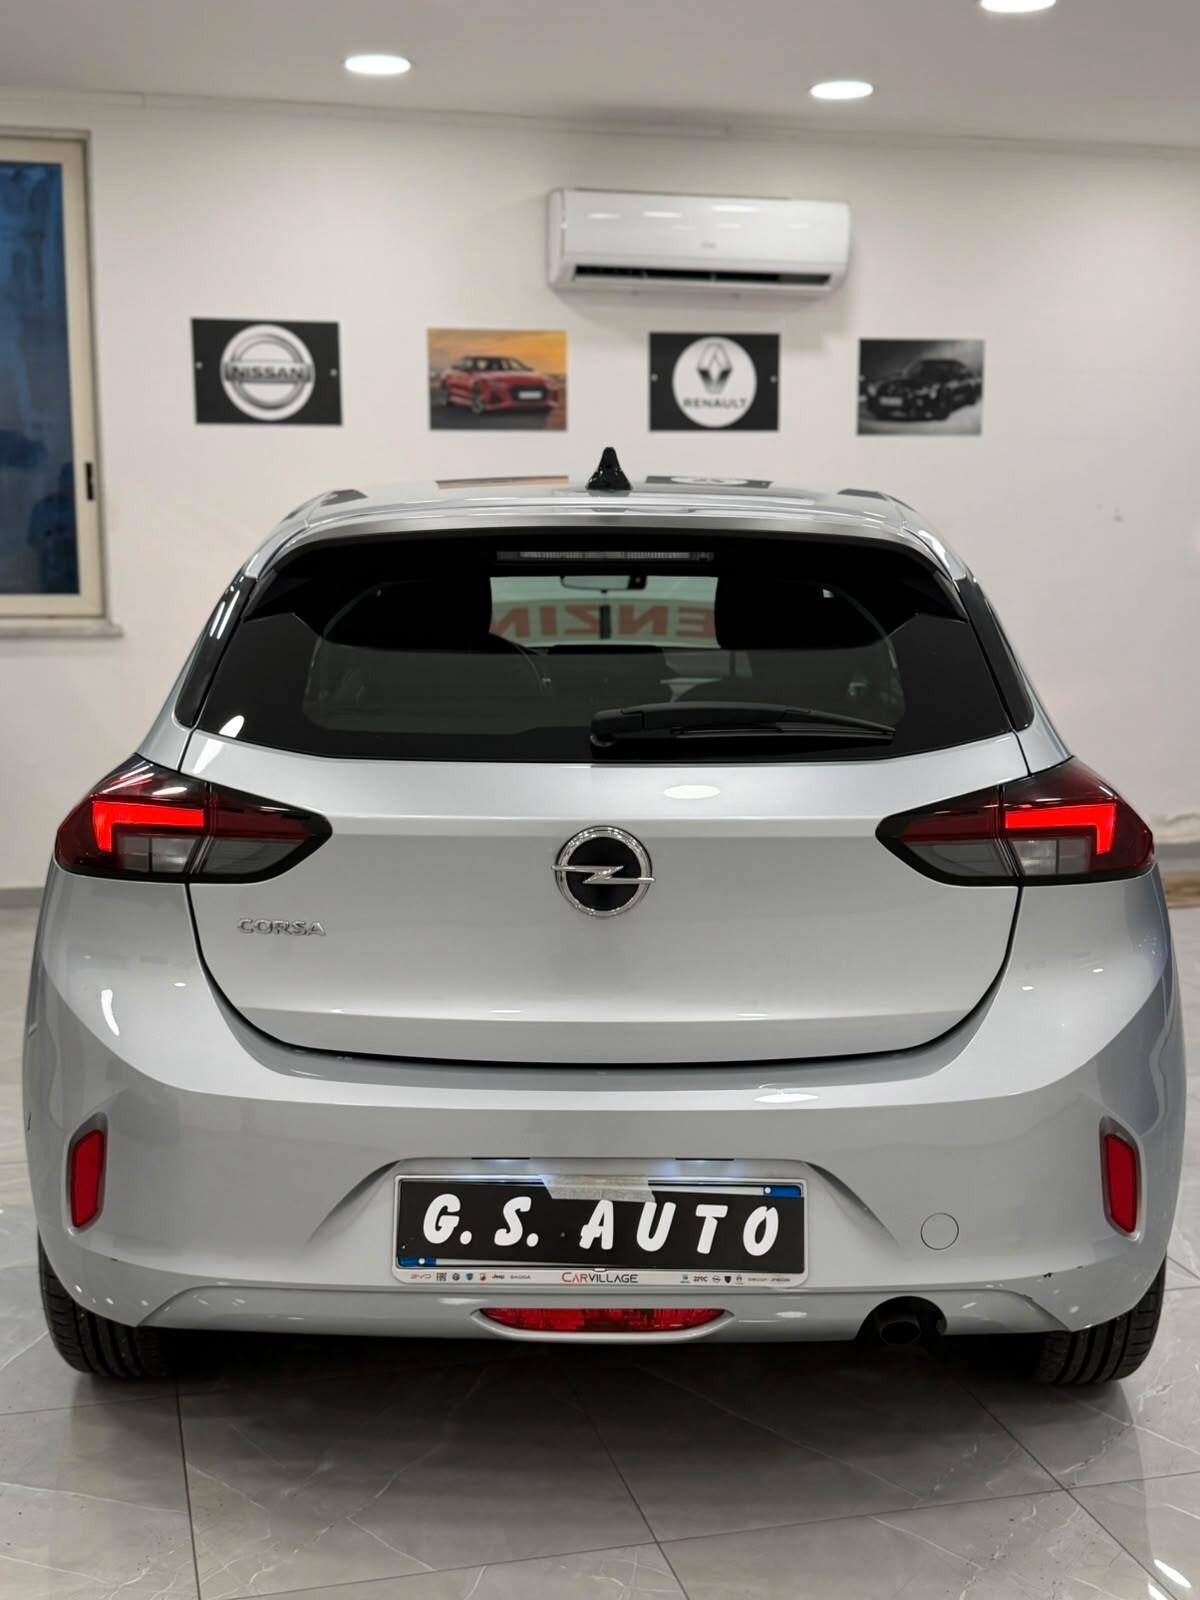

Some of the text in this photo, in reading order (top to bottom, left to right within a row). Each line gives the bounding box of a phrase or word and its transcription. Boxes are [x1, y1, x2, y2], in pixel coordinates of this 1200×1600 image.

[230, 366, 302, 379] NISSAN
[683, 398, 747, 408] RENAULT
[237, 919, 327, 936] CORSA
[423, 1193, 780, 1256] G. S. AUTO
